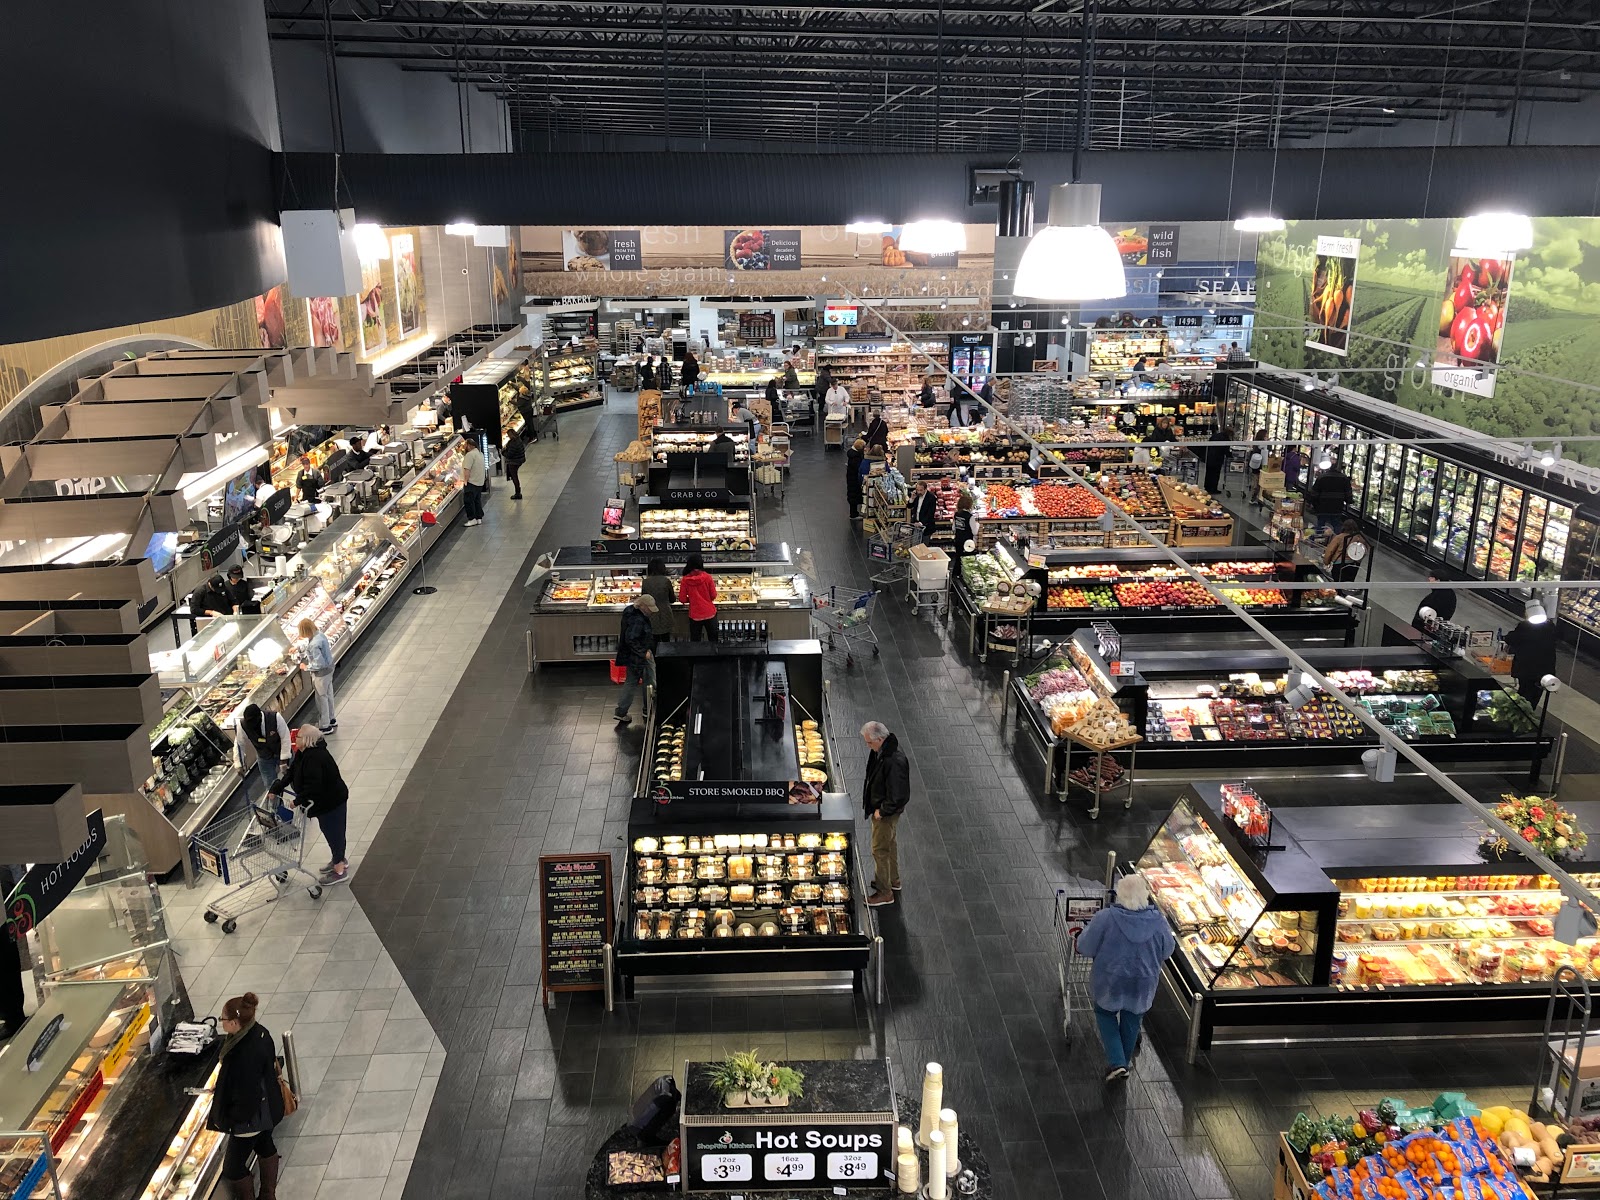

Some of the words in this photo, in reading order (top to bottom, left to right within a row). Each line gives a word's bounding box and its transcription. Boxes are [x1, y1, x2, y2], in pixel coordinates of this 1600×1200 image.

[1152, 231, 1174, 240] wild
[614, 239, 636, 248] fresh
[1335, 241, 1354, 254] fresh
[614, 253, 636, 261] oven
[773, 253, 797, 261] treats
[1151, 248, 1173, 258] fish
[562, 294, 592, 305] BAKERY
[1443, 370, 1479, 390] organic
[670, 491, 694, 499] GRAB
[212, 530, 239, 556] SANDWICHES
[629, 541, 663, 551] OLIVE
[666, 541, 688, 550] BAR
[688, 787, 720, 796] STORE
[721, 787, 763, 796] SMOKED
[765, 787, 785, 798] BBQ
[40, 862, 63, 896] HOT
[696, 1143, 728, 1151] ShopRite
[756, 1131, 799, 1149] Hot
[805, 1130, 883, 1151] Soups
